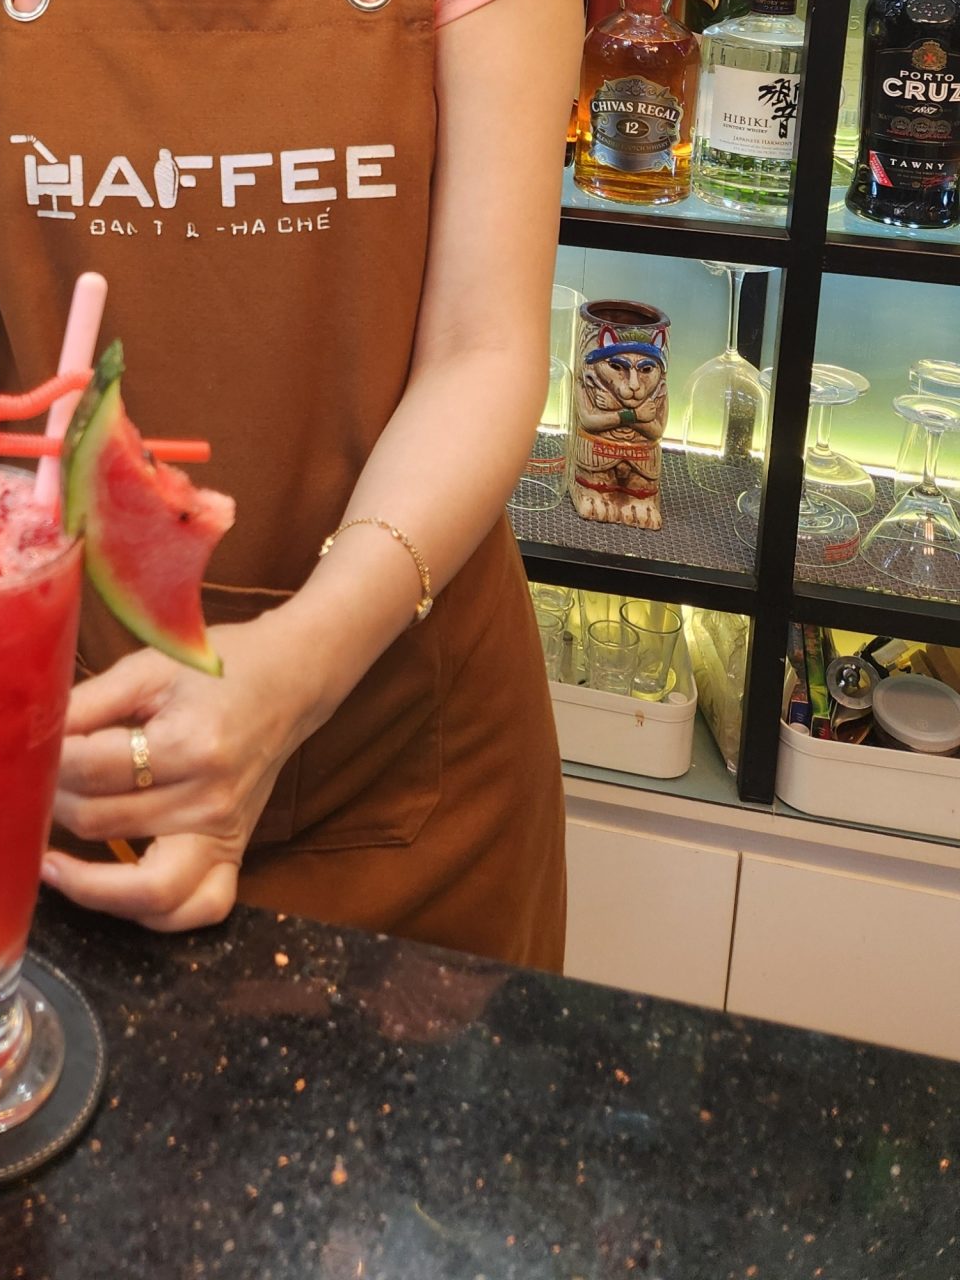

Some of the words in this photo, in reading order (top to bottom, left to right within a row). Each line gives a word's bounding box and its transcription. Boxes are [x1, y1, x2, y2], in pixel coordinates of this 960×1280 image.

[899, 70, 955, 82] PORTO
[882, 77, 960, 103] CRUZ
[591, 100, 634, 113] CHIVAS
[637, 102, 678, 123] REGAL
[723, 111, 769, 129] HIBIKI
[624, 121, 640, 135] 12
[889, 158, 946, 172] TAWNY
[10, 133, 398, 220] HAFFEE
